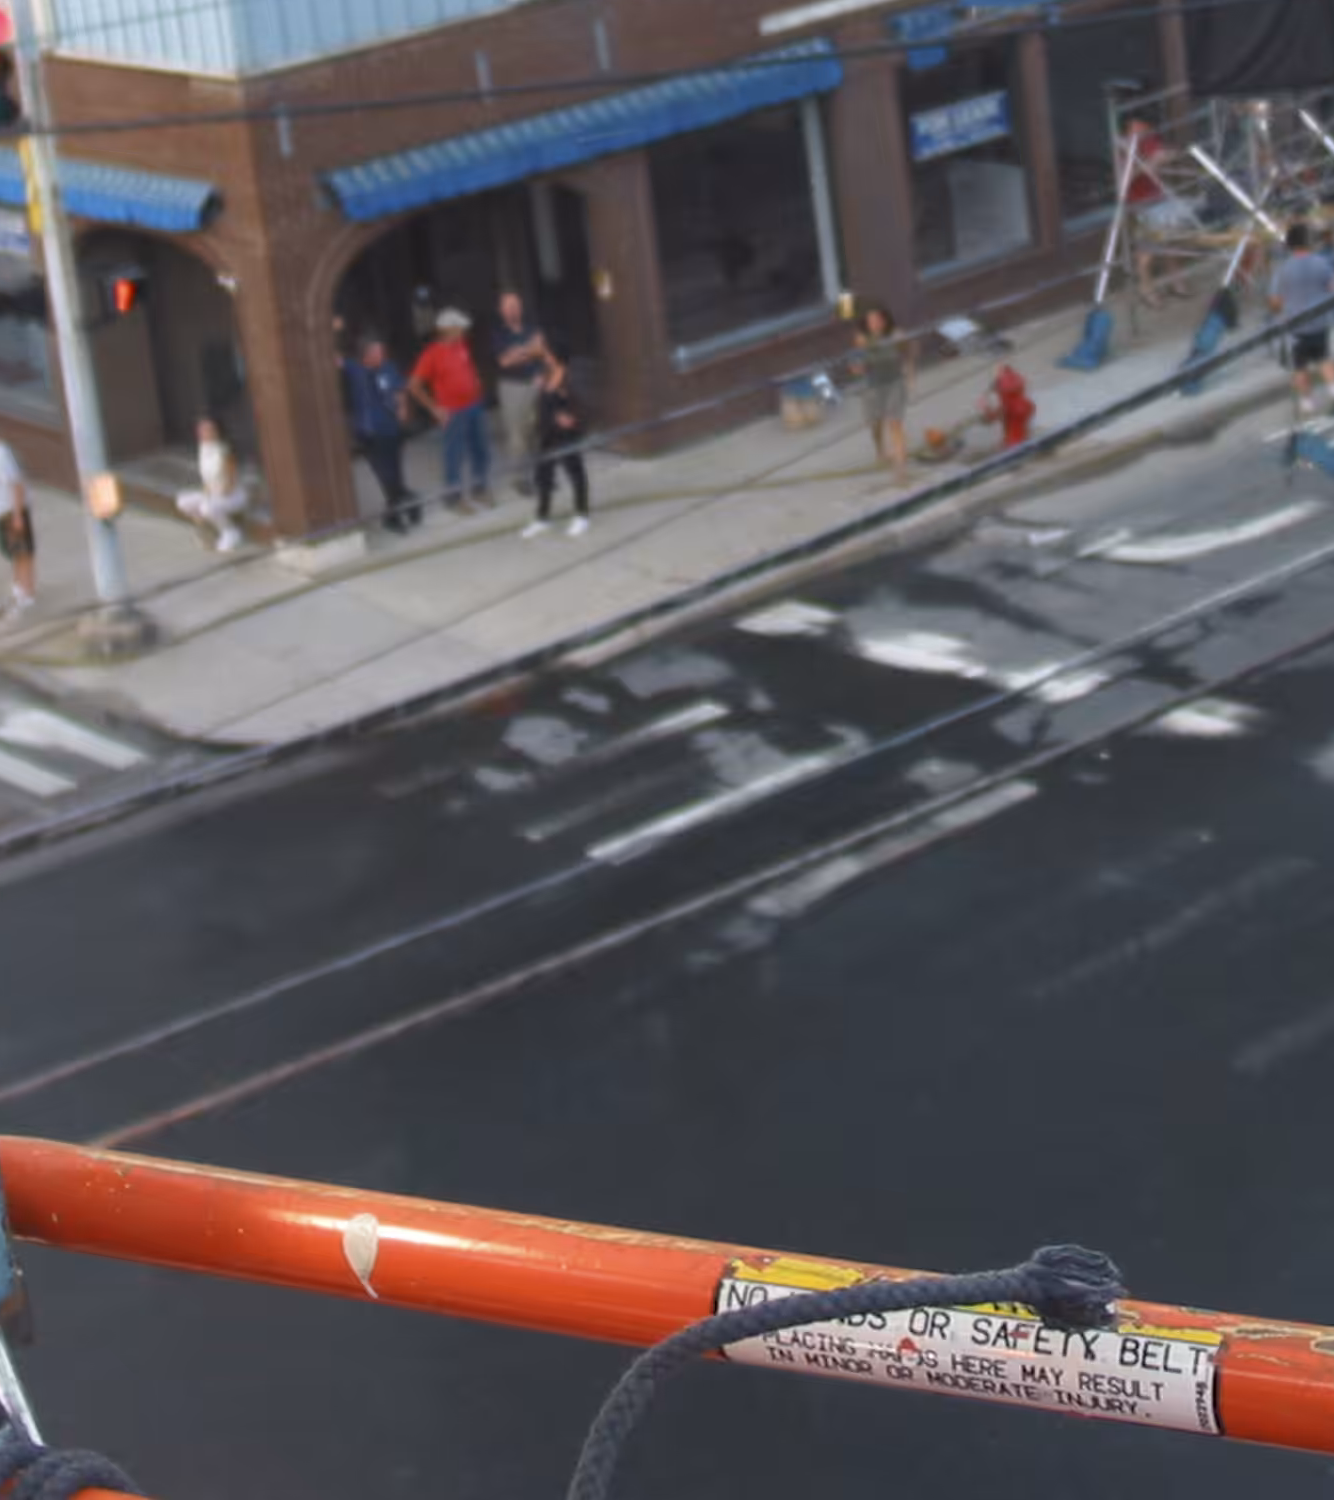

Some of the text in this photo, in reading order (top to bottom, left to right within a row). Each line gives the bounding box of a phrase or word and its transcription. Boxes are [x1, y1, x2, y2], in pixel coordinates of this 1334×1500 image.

[909, 1308, 951, 1340] OR
[970, 1317, 1099, 1360] SAFETY
[1119, 1337, 1207, 1375] BELT
[766, 1346, 1152, 1419] IN MINOR OR MODERATE INJURY.
[951, 1354, 1007, 1380] HERE
[1021, 1365, 1064, 1386] MAY
[1078, 1372, 1164, 1402] RESULT
